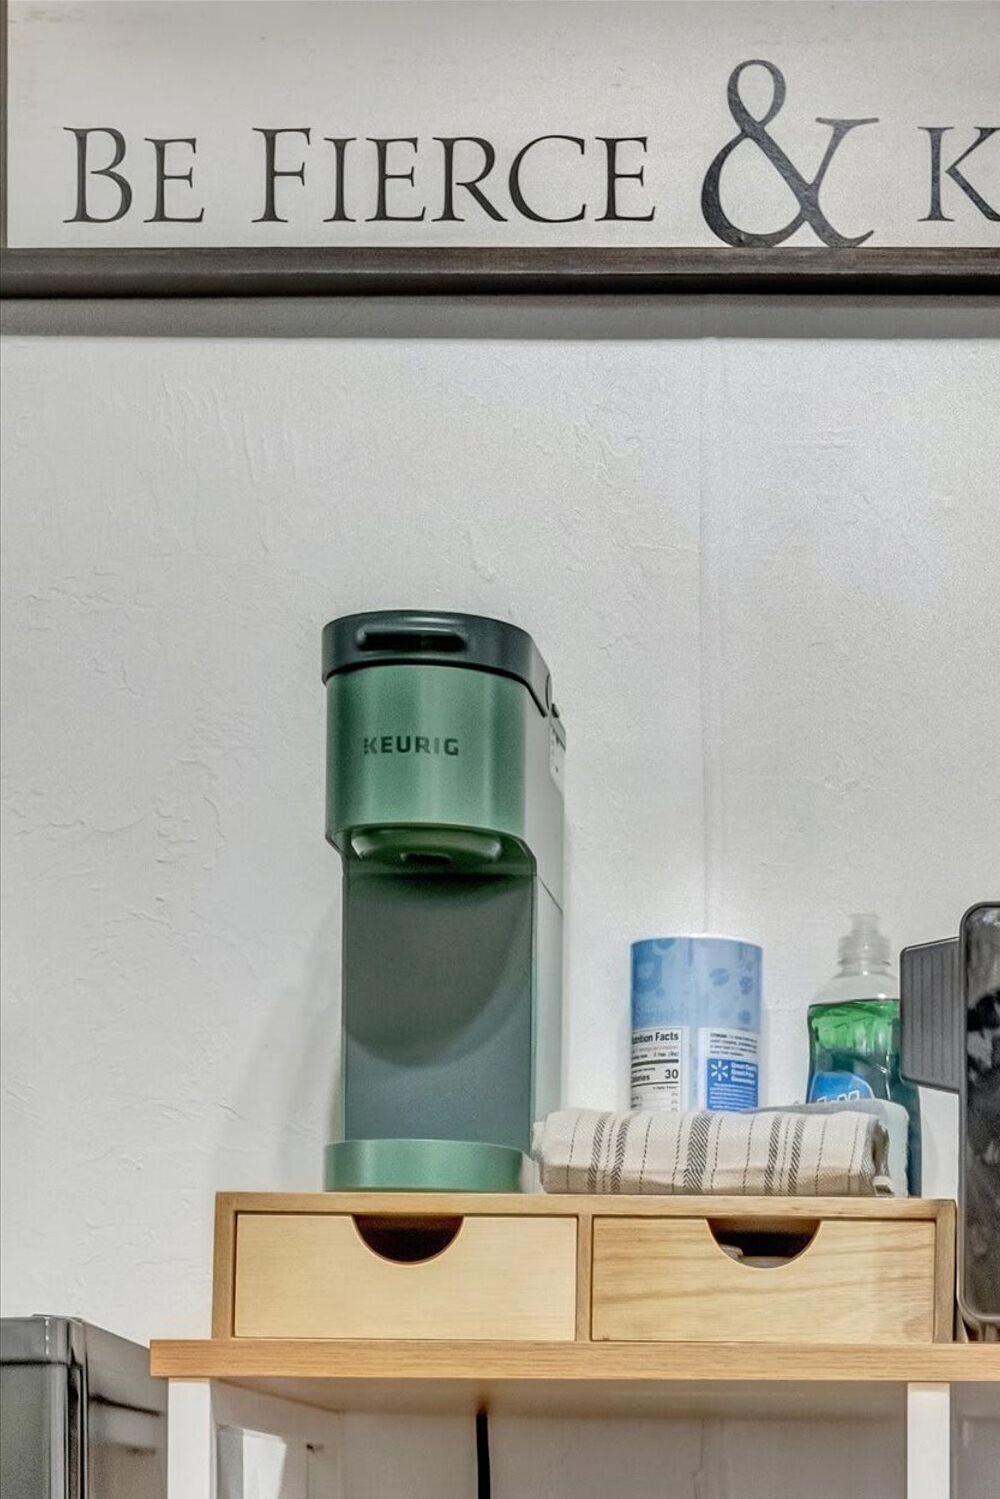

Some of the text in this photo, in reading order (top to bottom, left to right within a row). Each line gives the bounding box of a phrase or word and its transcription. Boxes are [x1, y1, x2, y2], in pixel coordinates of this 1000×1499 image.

[63, 126, 205, 224] BE
[251, 126, 656, 224] FIERCE
[701, 59, 879, 248] &
[363, 736, 460, 756] KEURIG
[655, 1032, 680, 1041] Facts
[665, 1069, 679, 1079] 30
